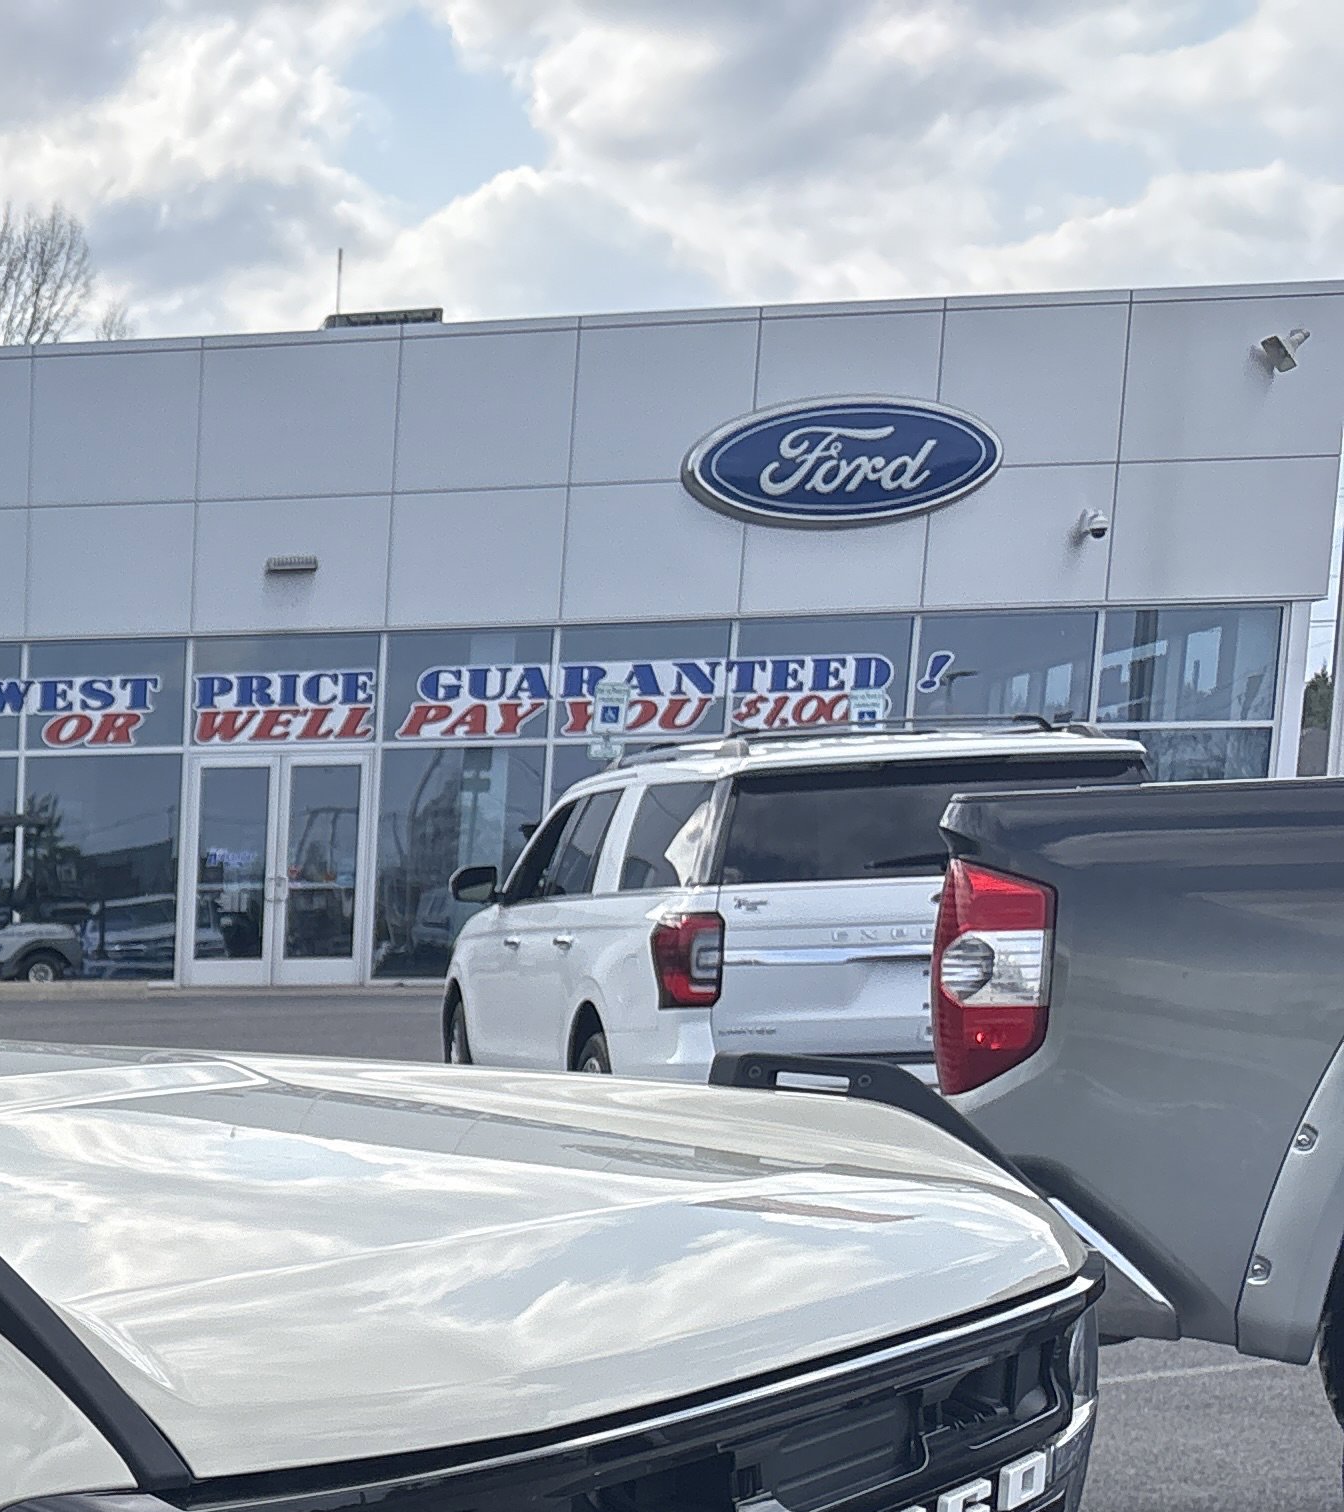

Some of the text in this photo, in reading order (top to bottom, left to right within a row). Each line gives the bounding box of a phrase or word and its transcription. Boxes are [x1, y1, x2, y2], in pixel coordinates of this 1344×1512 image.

[759, 425, 938, 497] Ford
[196, 671, 374, 709] PRICE
[420, 657, 892, 700] GUARANTEED
[42, 711, 144, 745] OR
[196, 707, 374, 743] WE'LL
[399, 701, 546, 737] PAY
